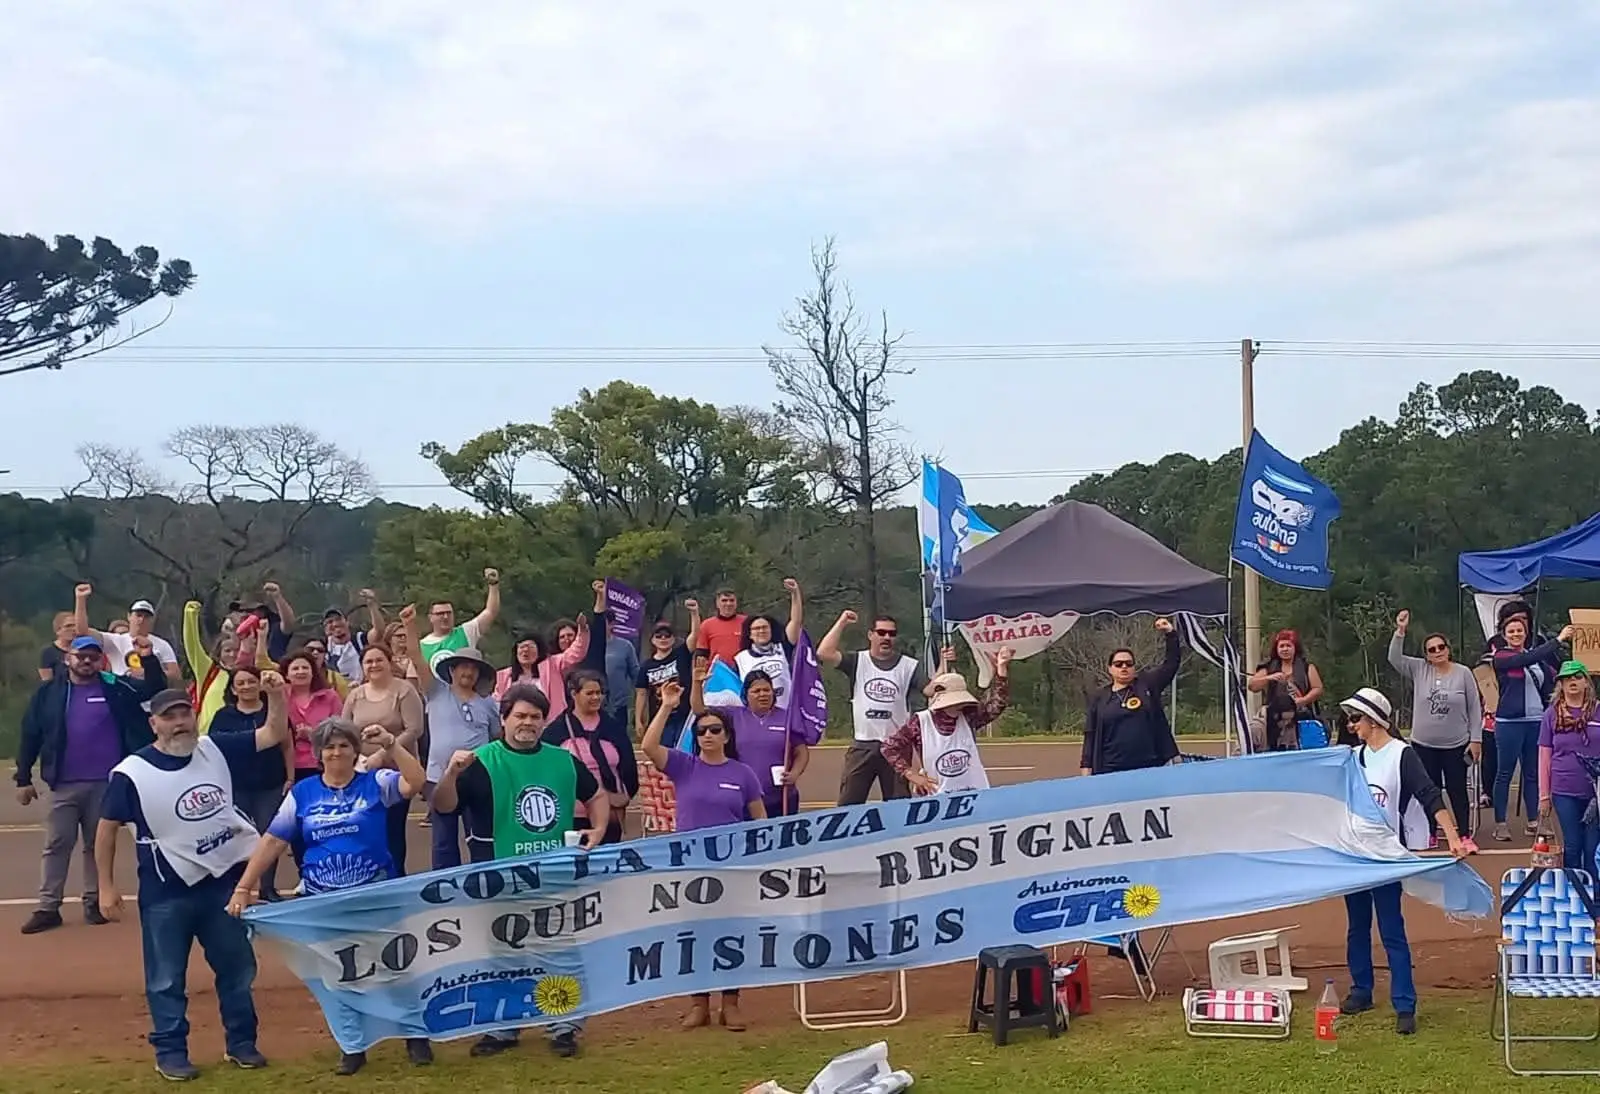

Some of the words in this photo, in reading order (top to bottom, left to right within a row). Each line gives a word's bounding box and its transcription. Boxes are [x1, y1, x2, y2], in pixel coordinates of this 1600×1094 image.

[523, 793, 554, 823] ATE
[312, 825, 359, 841] Misiones
[419, 861, 542, 905] CON
[669, 807, 887, 867] FUERZA
[903, 793, 978, 827] DE
[515, 839, 562, 855] PRENS
[334, 917, 463, 983] LOS
[491, 891, 603, 949] QUE
[649, 876, 724, 913] NO
[759, 865, 827, 900] SE
[1013, 888, 1132, 935] CTA
[421, 977, 542, 1034] CTA
